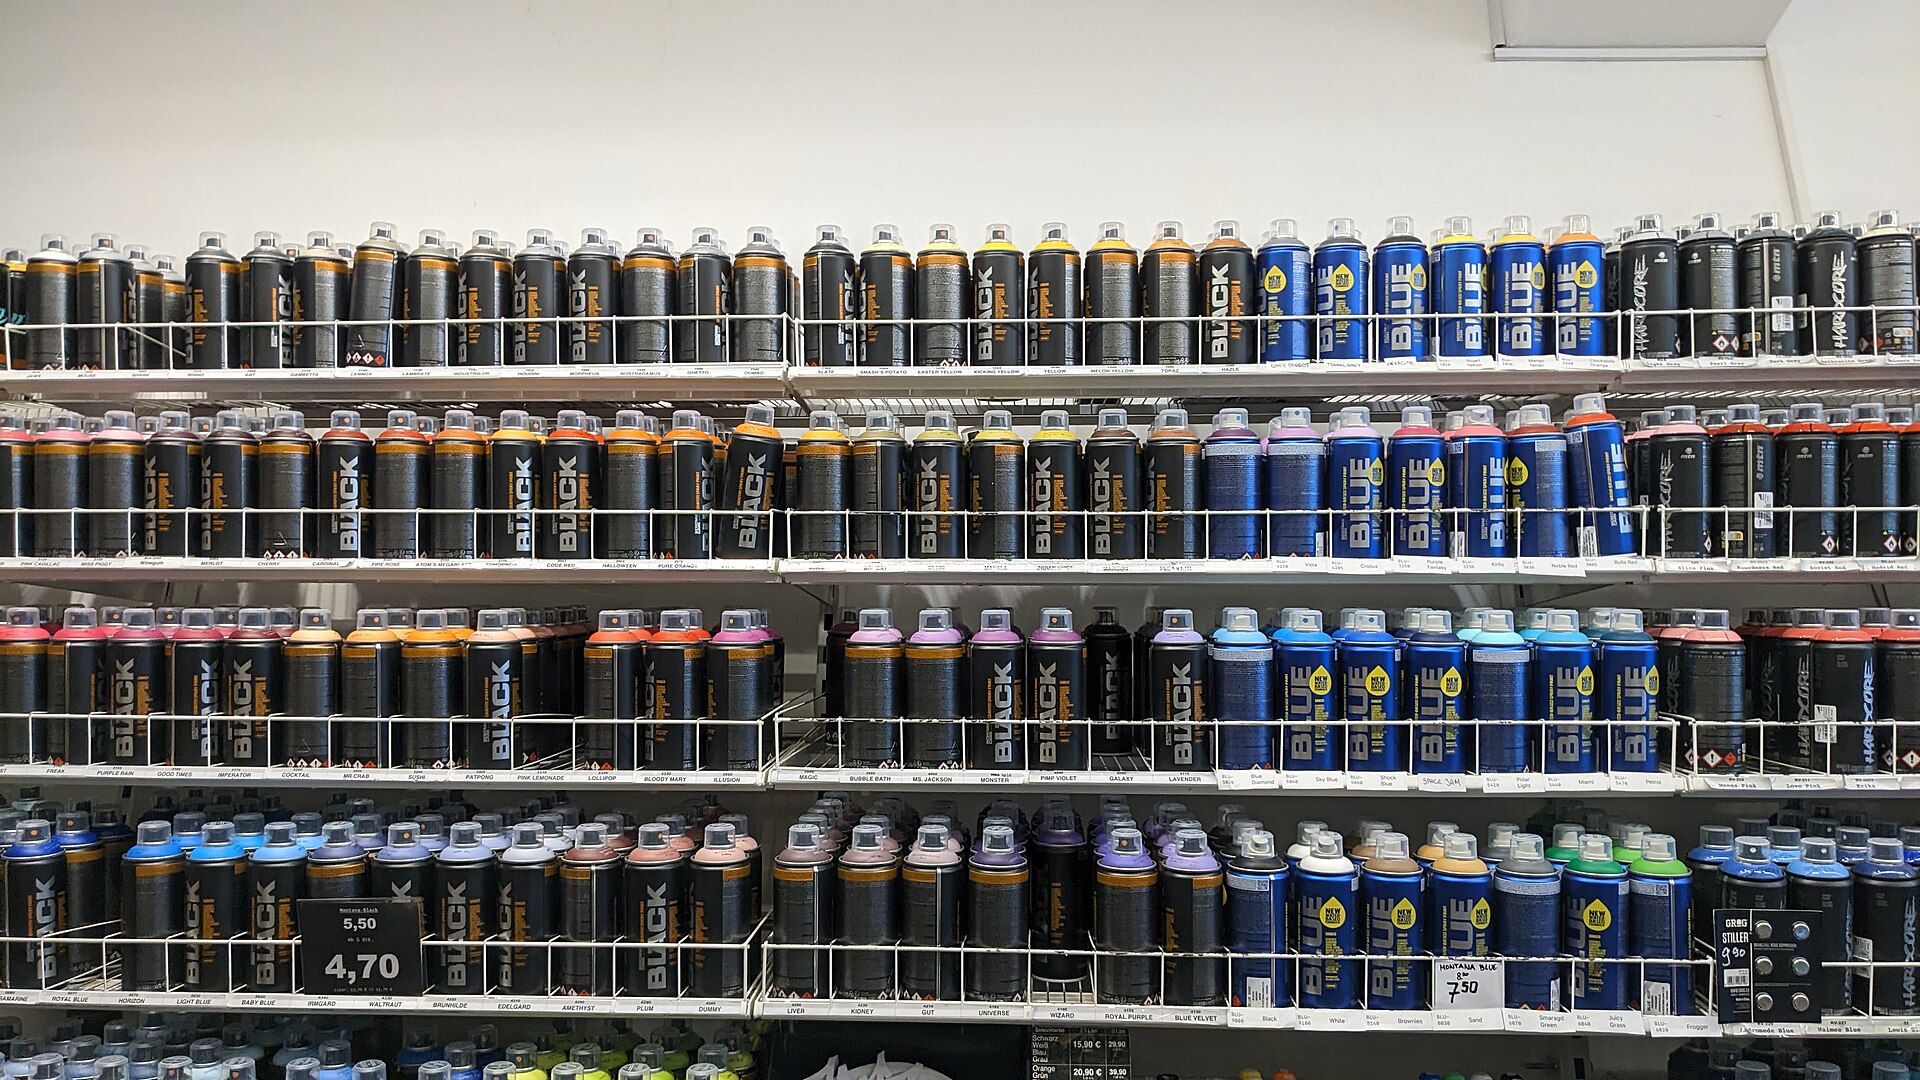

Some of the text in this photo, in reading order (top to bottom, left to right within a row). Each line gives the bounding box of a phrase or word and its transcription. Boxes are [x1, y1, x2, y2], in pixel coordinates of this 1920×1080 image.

[514, 270, 526, 362] BLACK
[572, 269, 586, 362] BLACK
[845, 269, 854, 362] BLACK
[978, 266, 993, 360] BLACK
[1030, 266, 1039, 360] BLACK
[1212, 263, 1229, 358] BLACK
[1392, 264, 1412, 350] BLUE
[1465, 263, 1481, 350] BLUE
[1512, 262, 1532, 349] BLUE
[1634, 255, 1648, 353] HARDCORE
[1832, 251, 1848, 349] HARDCORE
[340, 456, 359, 550] BLACK
[559, 456, 577, 551] BLACK
[739, 453, 767, 549] BLACK
[921, 457, 939, 553] BLACK
[1036, 456, 1052, 553] BLACK
[1094, 456, 1111, 553] BLACK
[1350, 458, 1370, 548] BLUE
[1408, 459, 1430, 548] BLUE
[116, 659, 134, 757] BLACK
[234, 658, 252, 758] BLACK
[492, 659, 510, 760] BLACK
[994, 662, 1013, 763] BLACK
[1040, 662, 1058, 763] BLACK
[1172, 662, 1193, 764] BLACK
[1290, 666, 1312, 760] BLUE
[1421, 668, 1443, 761] BLUE
[1557, 667, 1579, 761] BLUE
[1625, 667, 1646, 761] BLUE
[1863, 658, 1876, 764] HARDCORE
[257, 880, 276, 985] BLACK
[324, 954, 400, 985] 4,70
[343, 918, 377, 932] 5,50
[447, 880, 467, 986] BLACK
[647, 882, 668, 989] BLACK
[1478, 964, 1498, 972] BLUE
[1722, 932, 1749, 944] STILLER
[1032, 1065, 1056, 1074] Orange
[1073, 1041, 1093, 1049] 15,90
[1073, 1068, 1094, 1077] 20,90
